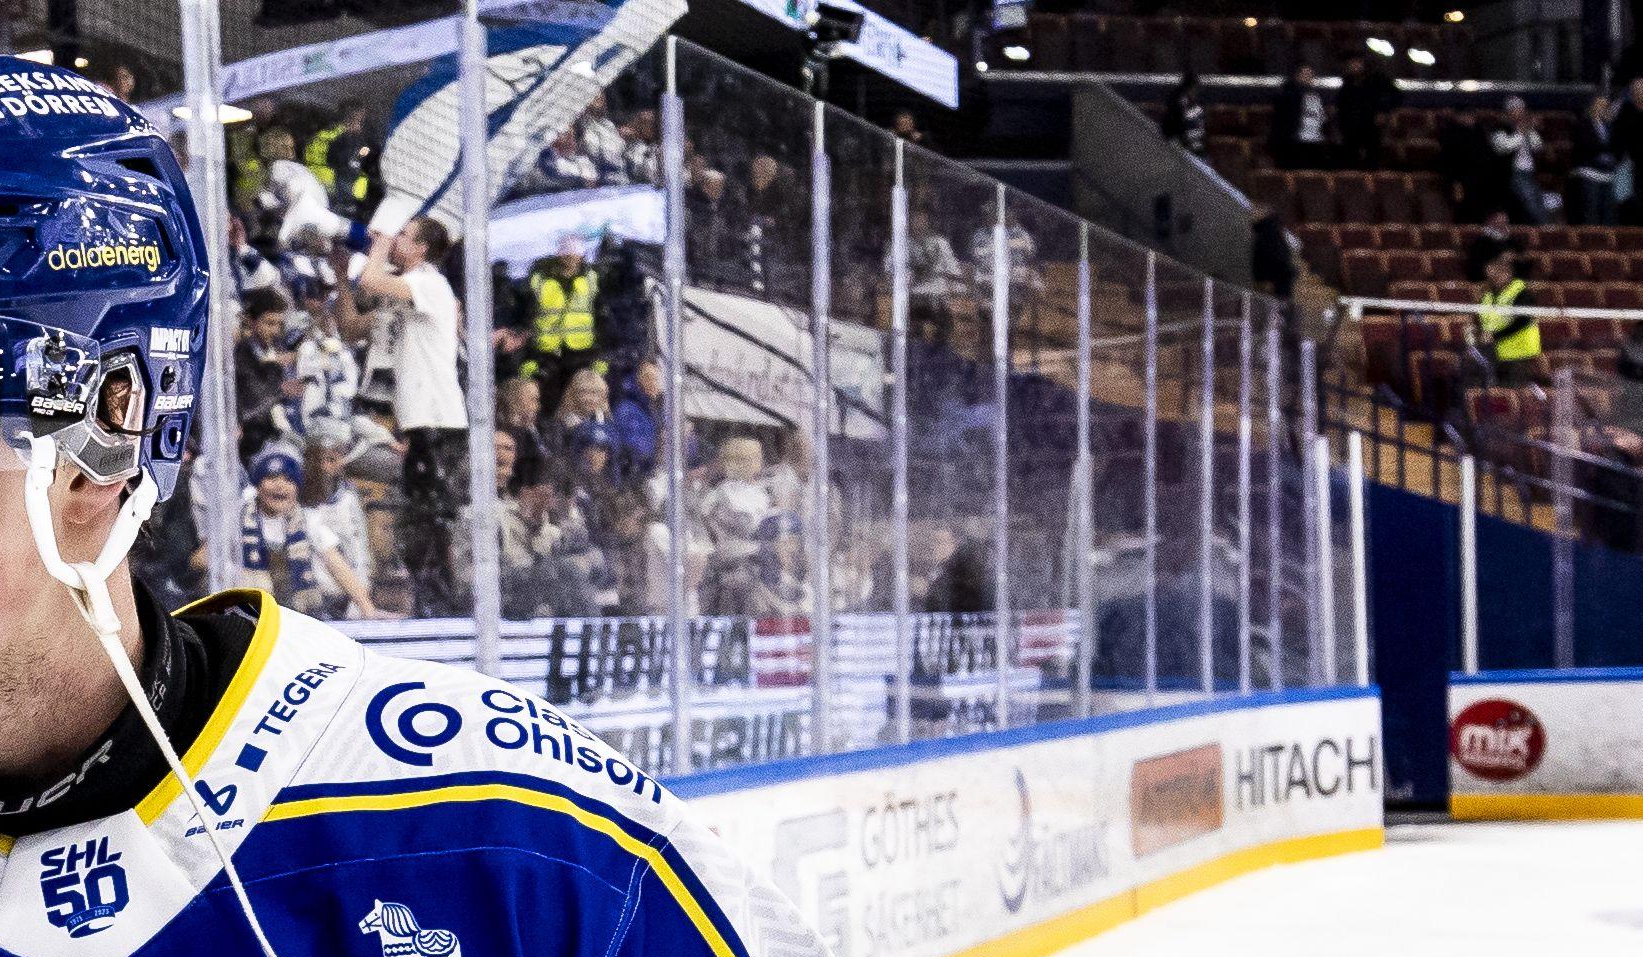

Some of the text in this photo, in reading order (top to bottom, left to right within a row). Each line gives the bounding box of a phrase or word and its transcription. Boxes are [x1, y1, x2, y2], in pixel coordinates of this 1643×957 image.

[48, 241, 161, 272] dalaenergi
[252, 662, 347, 736] TEGERA
[485, 716, 663, 805] Ohlson
[39, 835, 123, 880] SHL
[40, 862, 130, 928] 50
